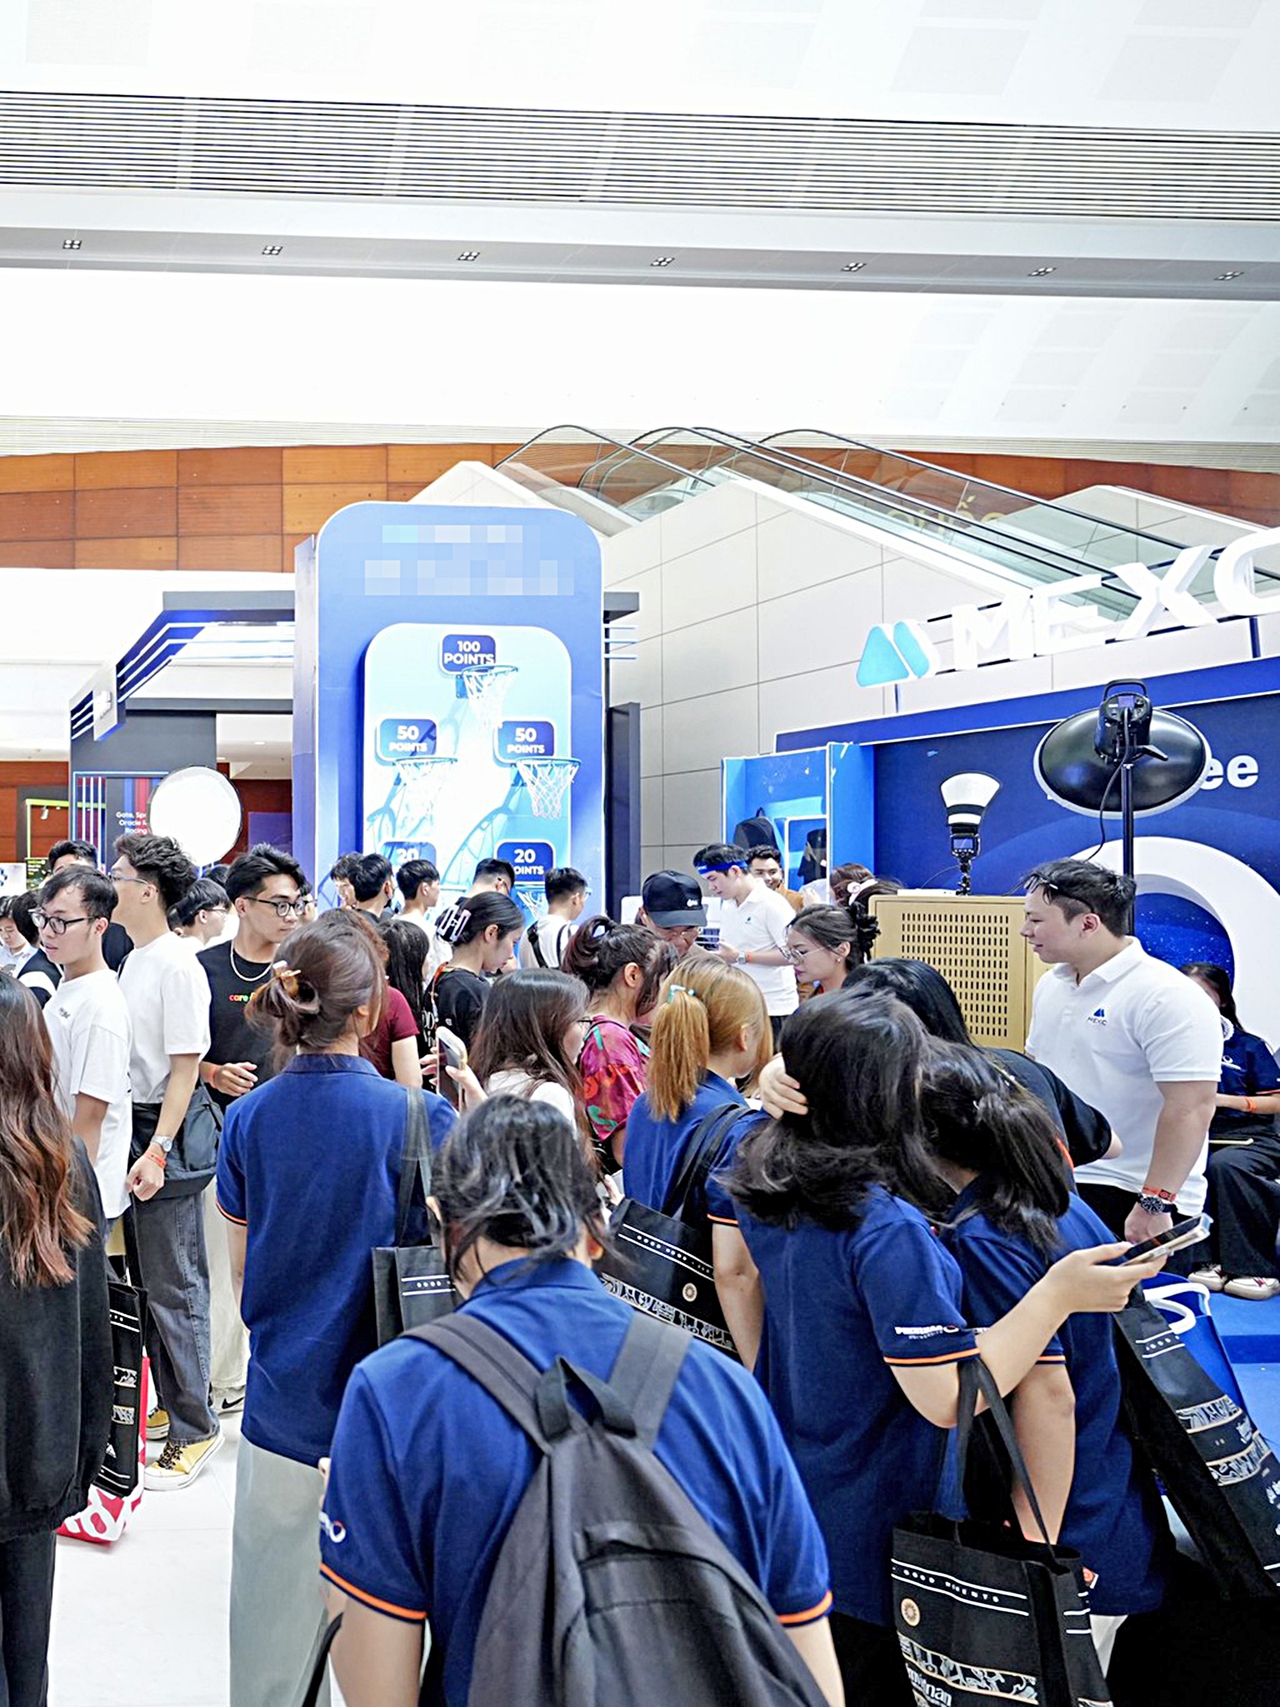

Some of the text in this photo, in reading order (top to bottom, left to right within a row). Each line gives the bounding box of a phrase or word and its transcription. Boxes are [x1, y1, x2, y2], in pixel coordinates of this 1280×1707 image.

[951, 527, 1280, 670] MEXC
[457, 641, 481, 652] 100
[444, 653, 495, 665] POINTS
[397, 725, 420, 740] 50
[515, 727, 537, 742] 50
[389, 742, 428, 753] POINTS
[507, 744, 546, 754] POINTS
[396, 848, 419, 862] 20
[514, 849, 536, 863] 20
[513, 866, 544, 875] OINTS
